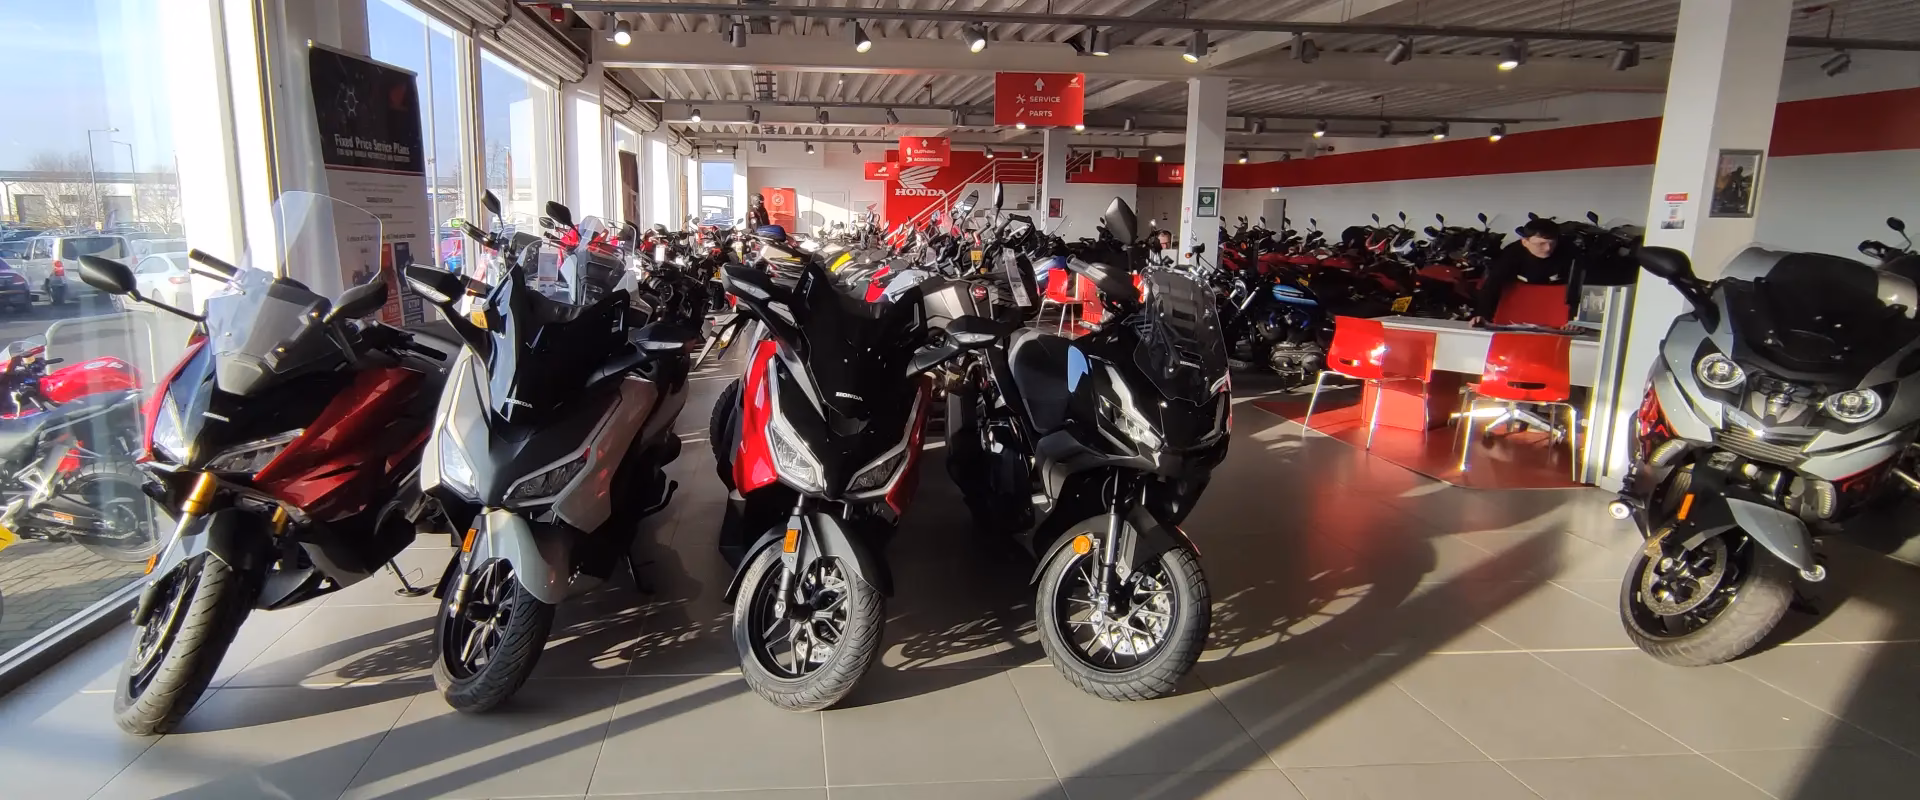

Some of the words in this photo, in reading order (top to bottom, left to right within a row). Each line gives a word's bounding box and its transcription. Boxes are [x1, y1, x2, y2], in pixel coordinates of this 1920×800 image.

[1029, 95, 1060, 103] SERVICE
[334, 133, 354, 148] Fixed
[355, 136, 373, 150] Price
[373, 139, 393, 153] Service
[393, 142, 410, 155] Plans
[895, 188, 947, 197] HONDA
[835, 391, 864, 402] HONDA
[505, 397, 534, 409] HONDA
